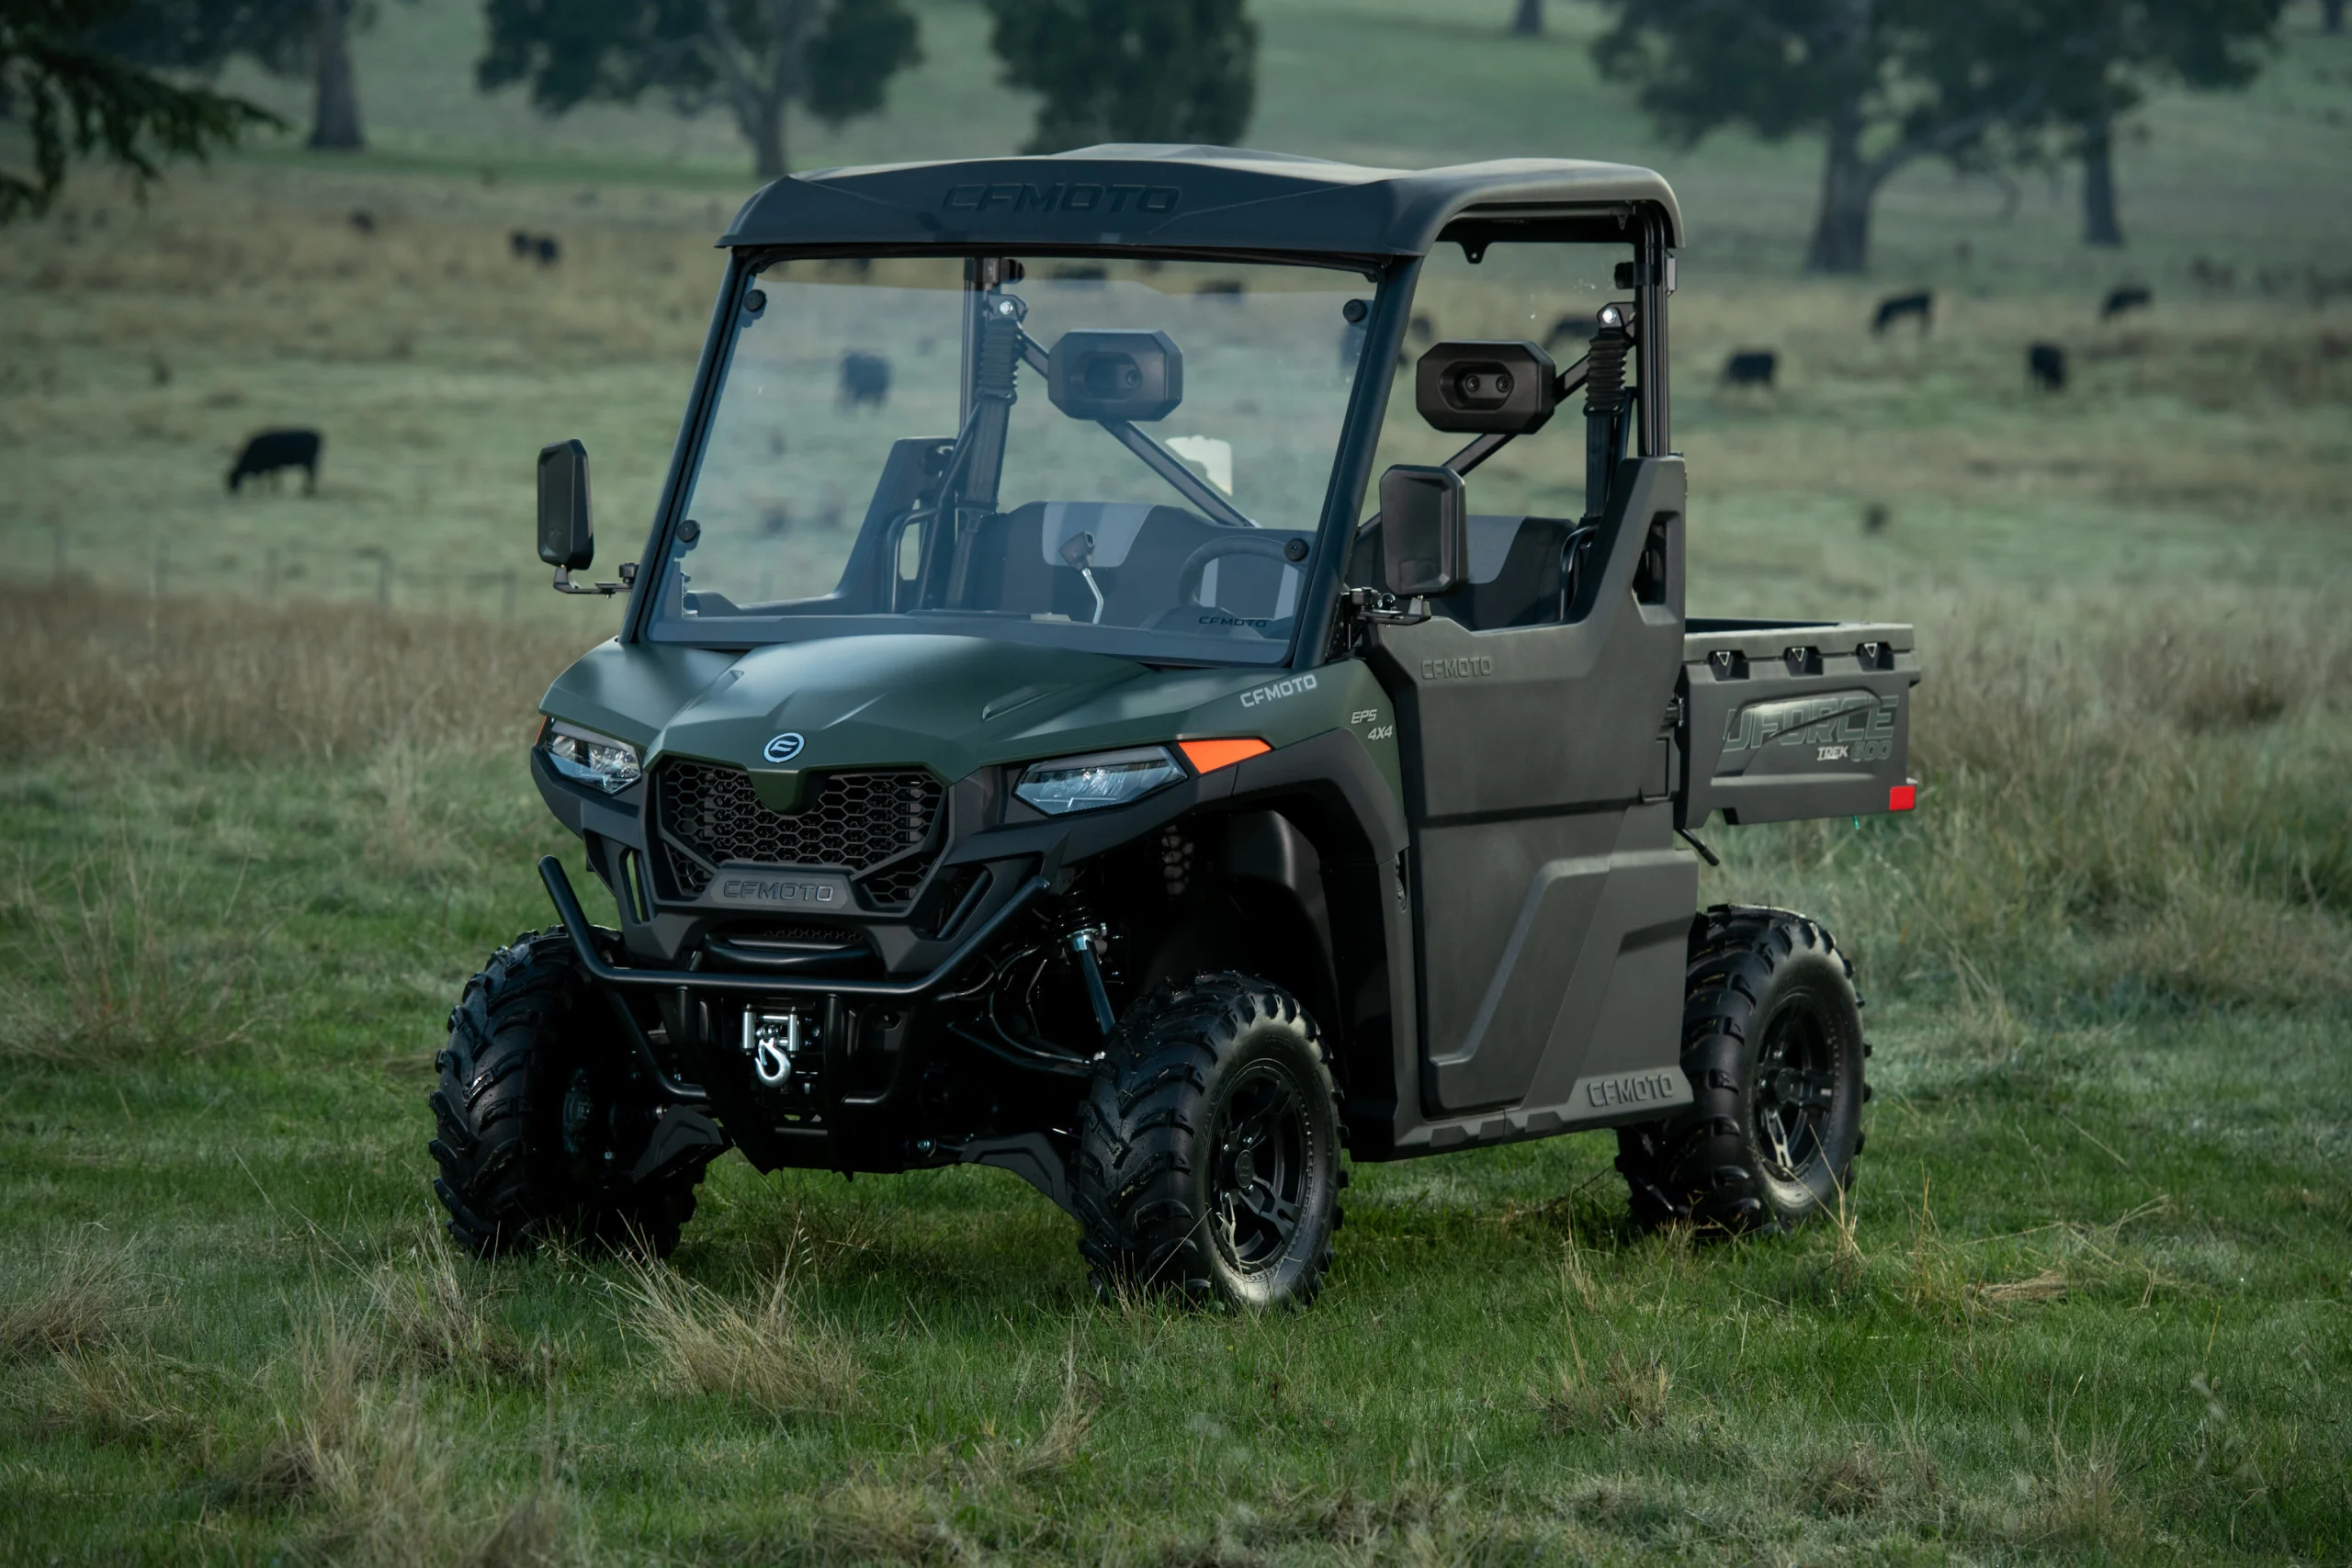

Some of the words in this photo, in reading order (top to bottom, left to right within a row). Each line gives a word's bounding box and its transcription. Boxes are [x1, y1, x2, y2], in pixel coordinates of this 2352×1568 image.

[942, 183, 1182, 213] CFMOTO
[1198, 616, 1267, 627] CFMOTO
[1421, 657, 1492, 680] CFMOTO
[1240, 674, 1317, 708] CFMOTO
[1351, 709, 1377, 724] EPS
[1816, 745, 1849, 761] TREK
[723, 880, 834, 902] CFMOTO
[1588, 1073, 1673, 1108] CFMOTO
